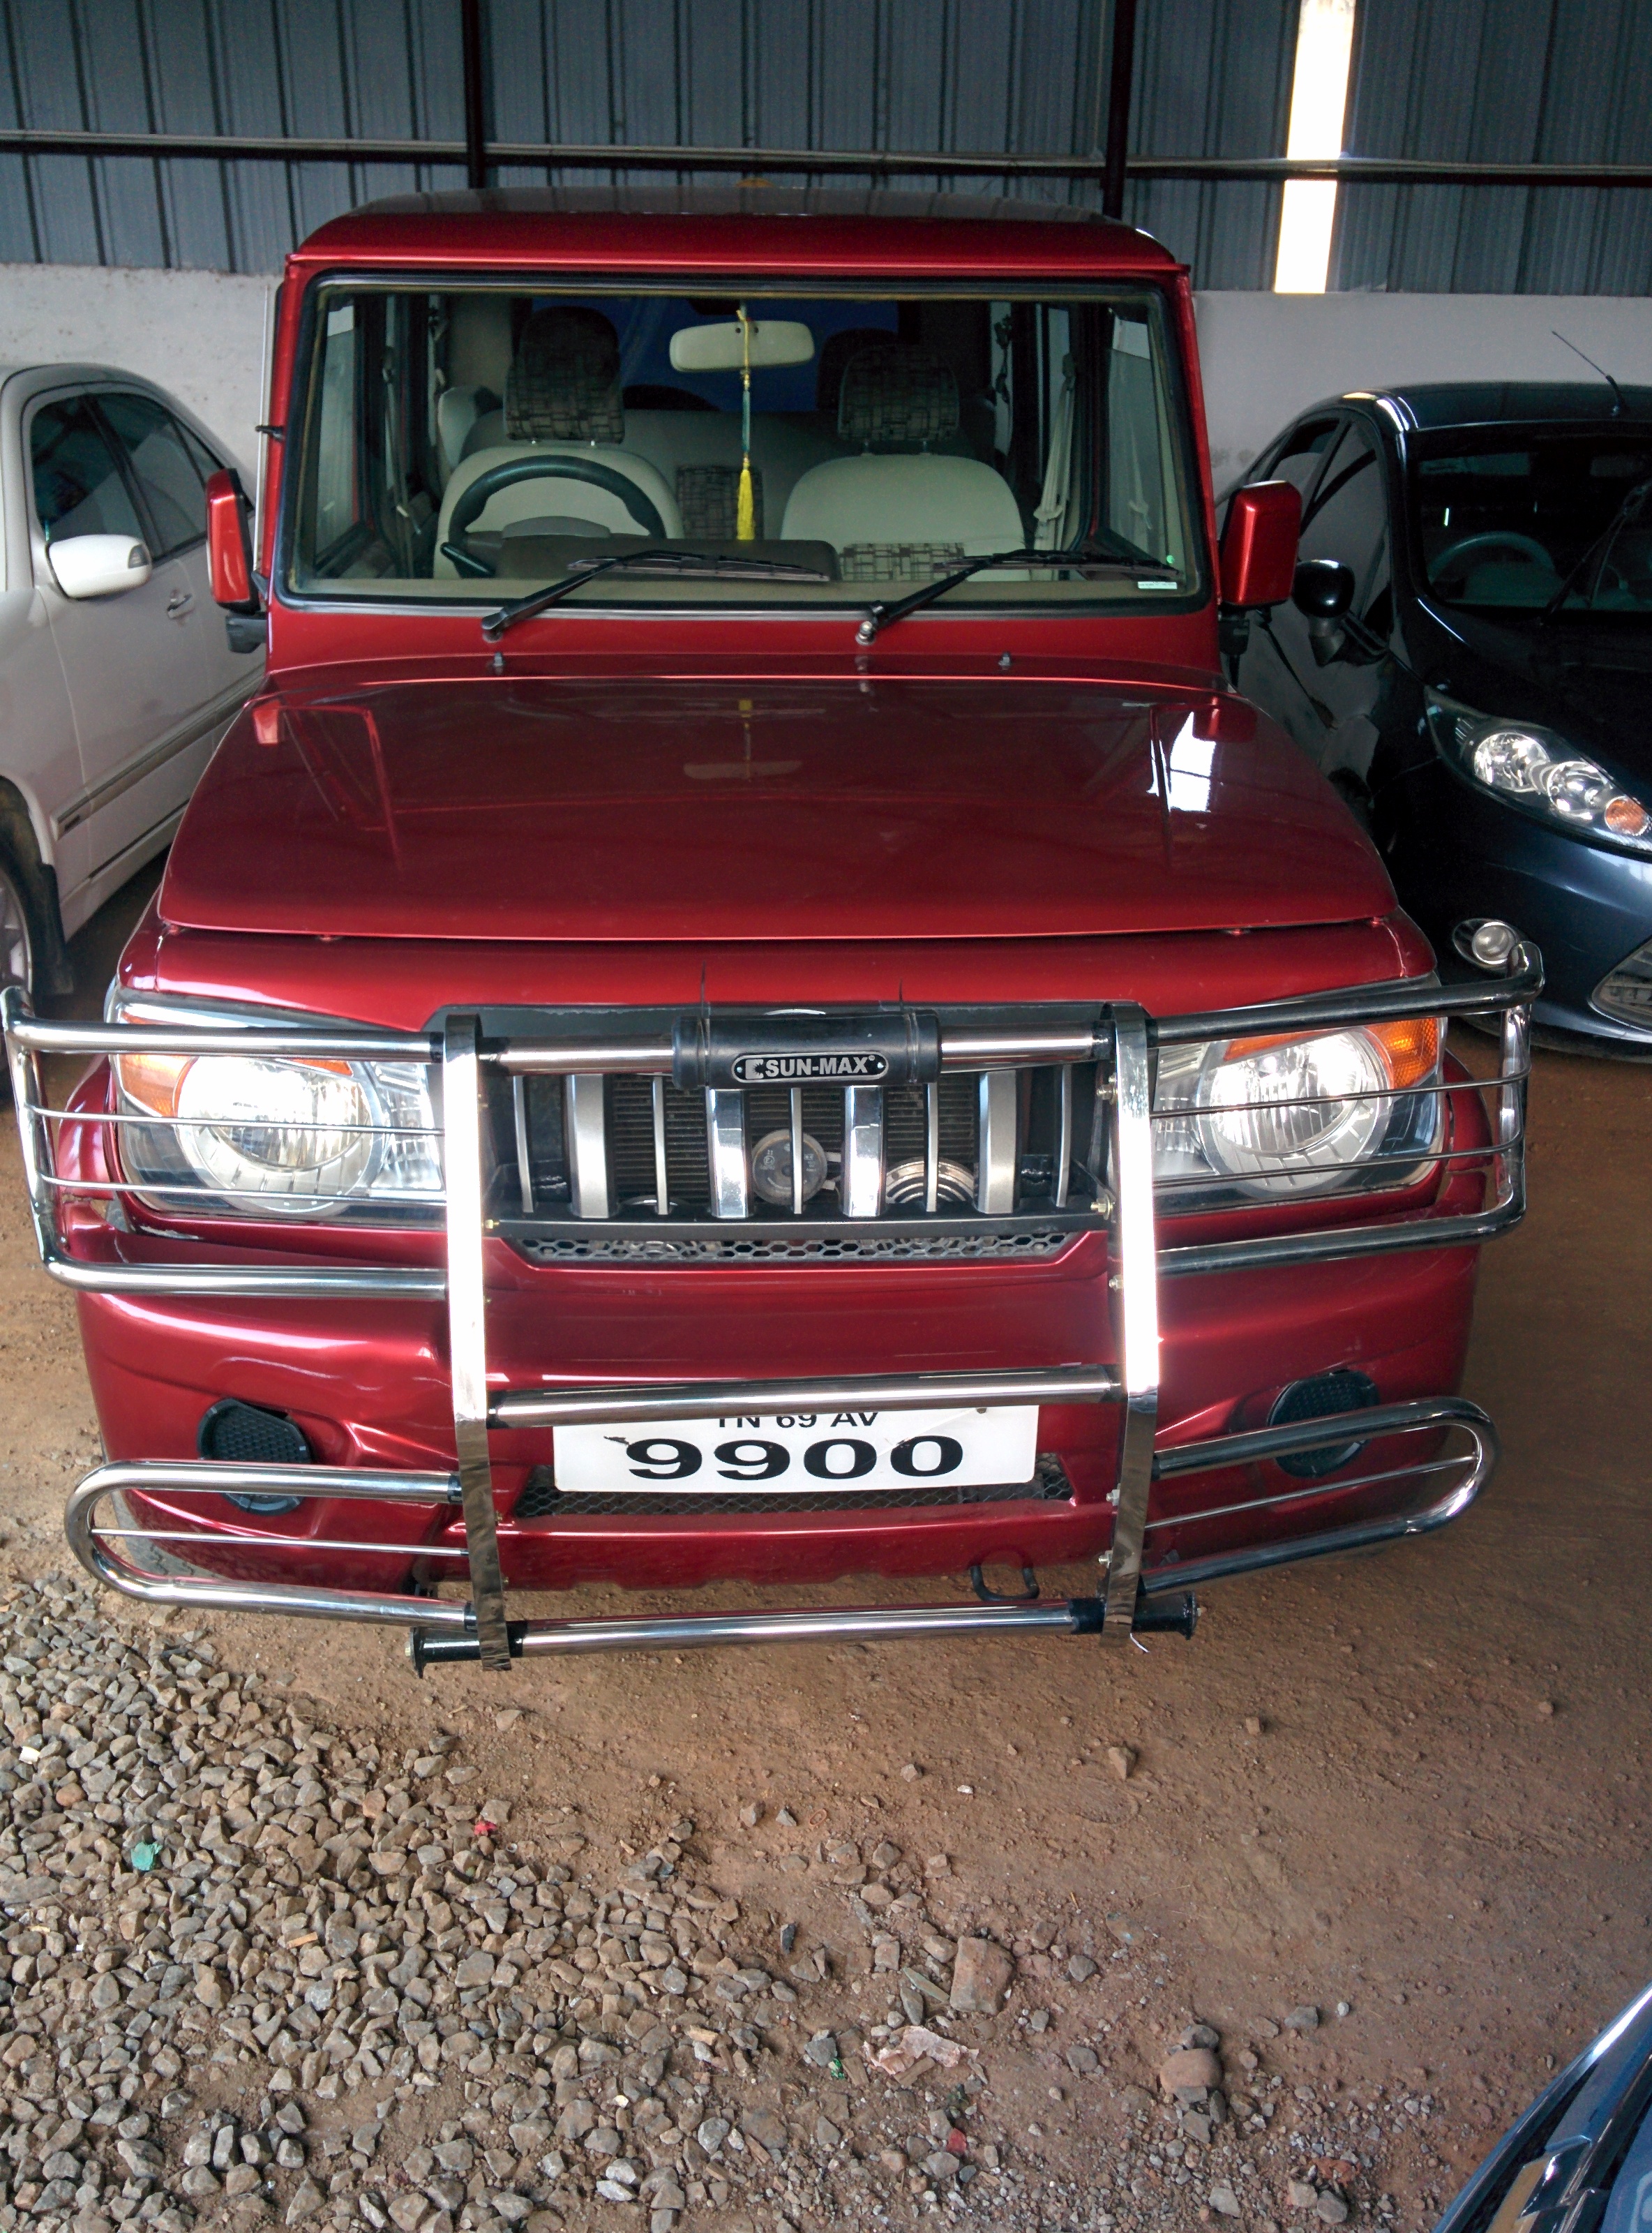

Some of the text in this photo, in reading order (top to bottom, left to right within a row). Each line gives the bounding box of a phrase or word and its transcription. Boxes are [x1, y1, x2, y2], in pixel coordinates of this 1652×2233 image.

[765, 1056, 869, 1077] SUN-MAX
[776, 1414, 817, 1428] 69
[830, 1412, 878, 1427] AV
[626, 1435, 963, 1481] 9900
